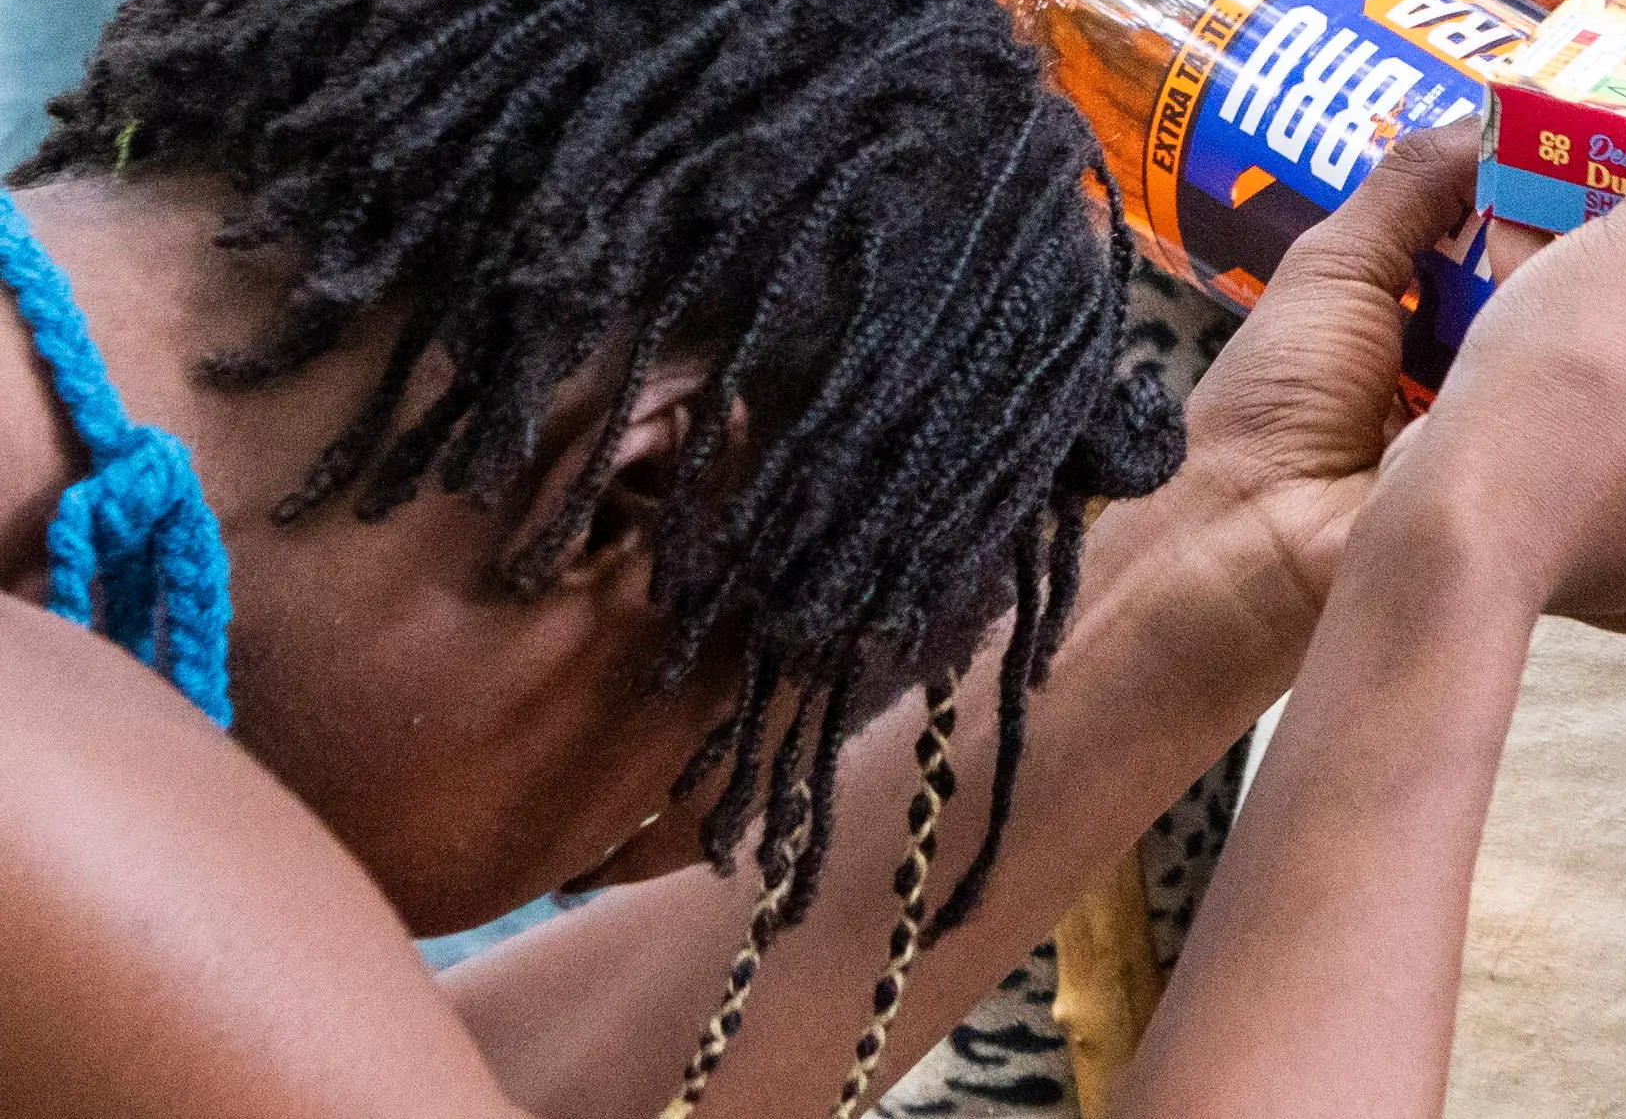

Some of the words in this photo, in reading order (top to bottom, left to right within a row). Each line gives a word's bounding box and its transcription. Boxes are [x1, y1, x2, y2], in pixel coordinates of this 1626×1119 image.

[1153, 87, 1193, 174] EXTRA
[1176, 10, 1243, 84] TASTE.
[1219, 5, 1424, 191] BRU
